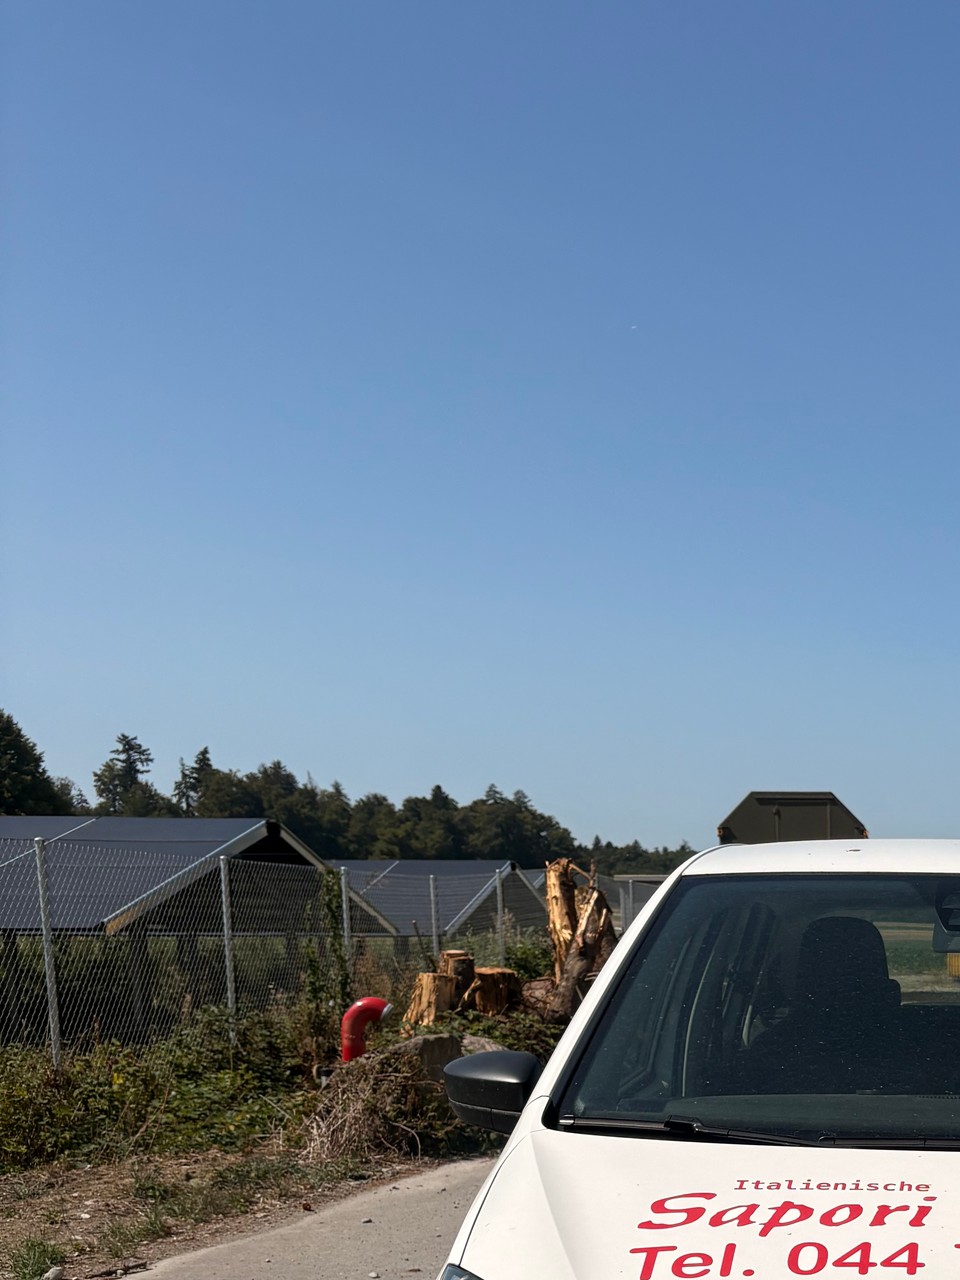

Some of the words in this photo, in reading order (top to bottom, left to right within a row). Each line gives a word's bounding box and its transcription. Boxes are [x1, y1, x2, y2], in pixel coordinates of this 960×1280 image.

[734, 1179, 931, 1192] Italienische
[637, 1191, 938, 1238] Sapori
[786, 1241, 925, 1276] 044
